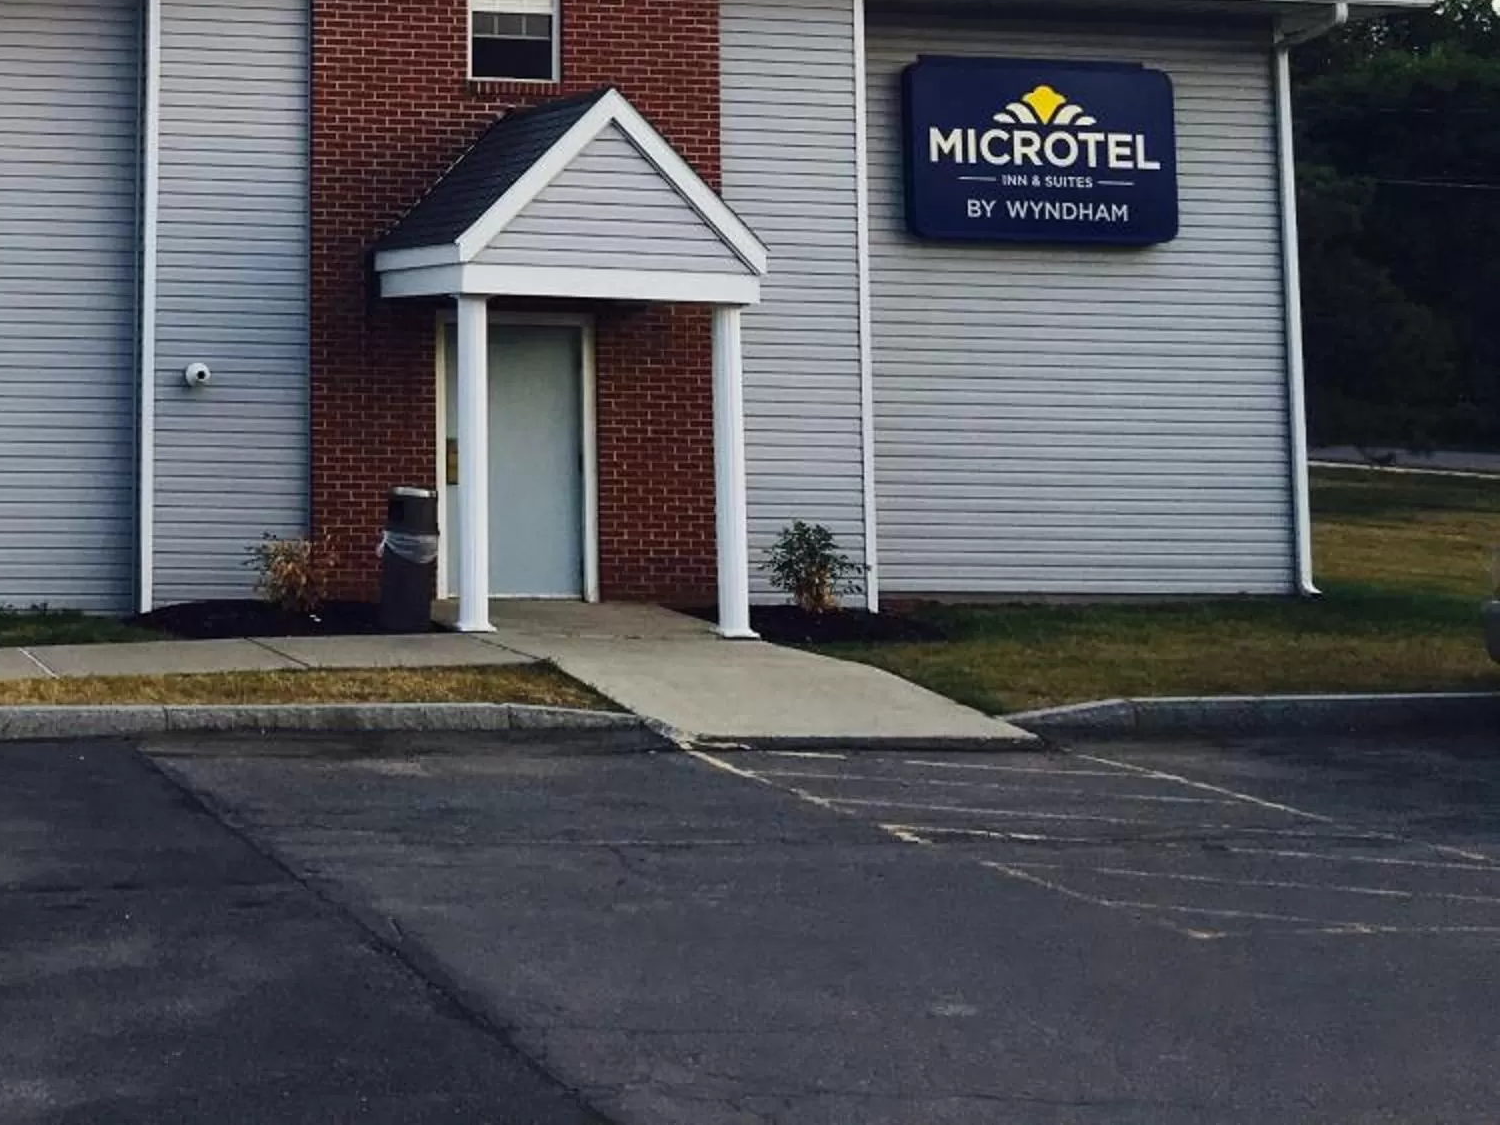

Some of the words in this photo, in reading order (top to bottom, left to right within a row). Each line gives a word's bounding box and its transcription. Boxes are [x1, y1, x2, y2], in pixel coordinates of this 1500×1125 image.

[929, 127, 1161, 170] MICROTEL
[1001, 175, 1028, 186] INN
[1031, 175, 1041, 187] &
[1045, 176, 1093, 188] SUITES
[967, 199, 996, 218] BY
[1006, 200, 1129, 222] WYNDHAM
